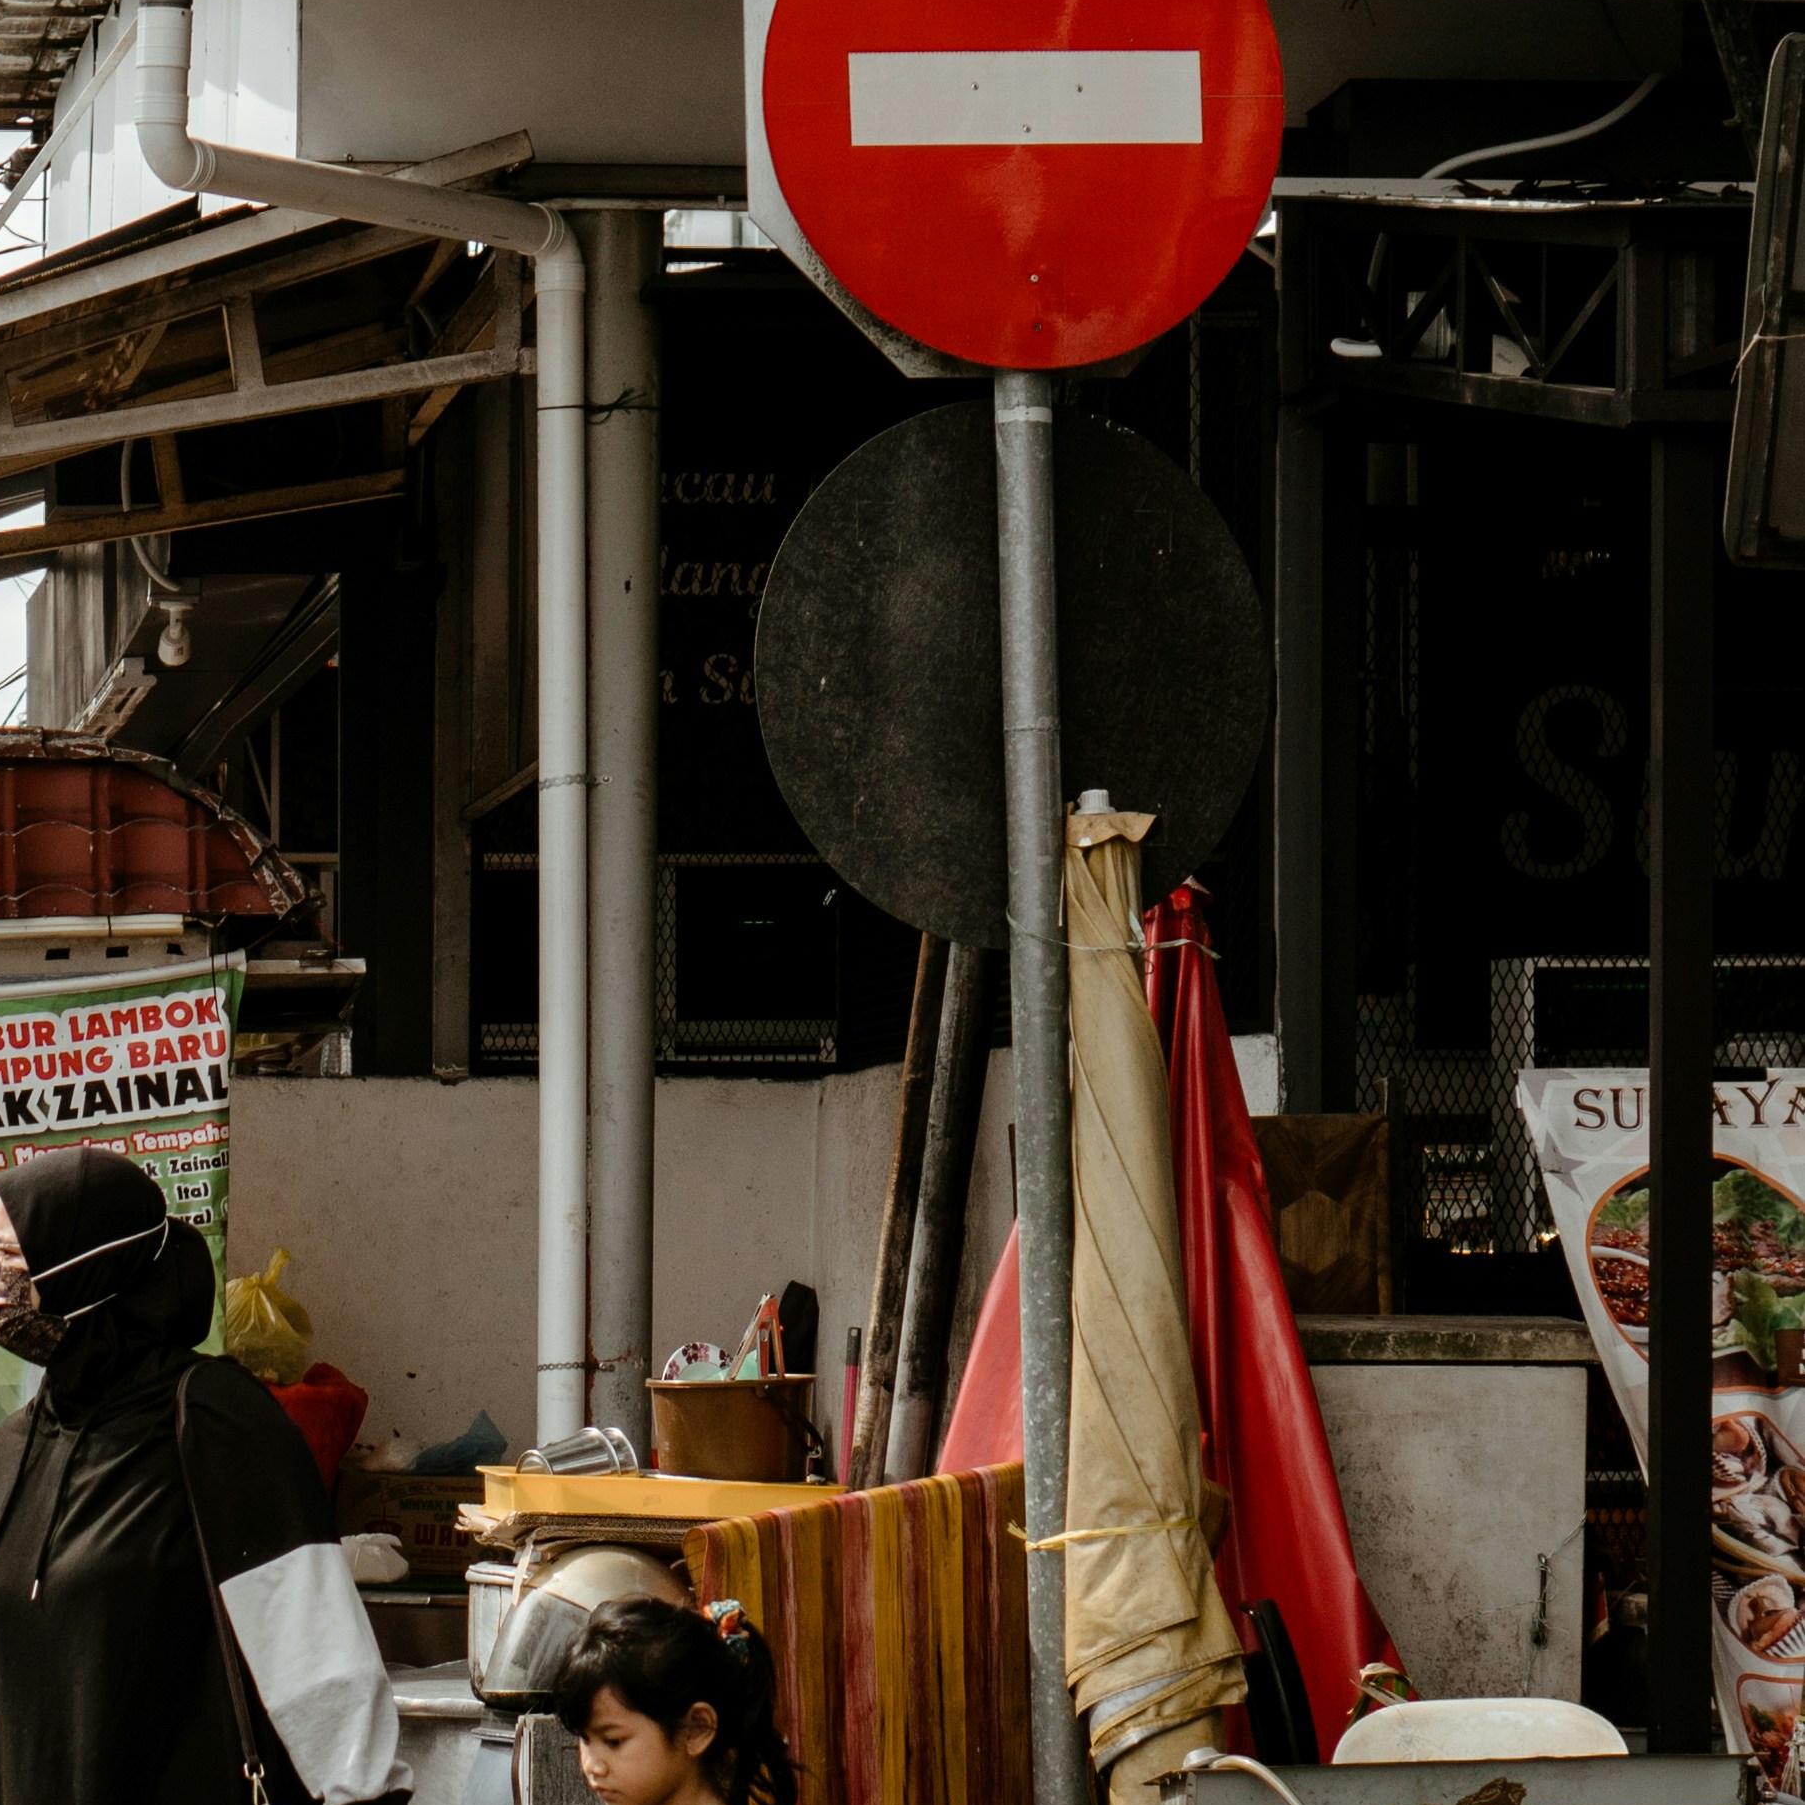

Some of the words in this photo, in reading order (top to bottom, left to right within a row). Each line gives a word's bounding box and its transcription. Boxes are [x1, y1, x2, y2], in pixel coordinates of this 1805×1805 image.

[68, 996, 220, 1042] LAMBOK
[127, 1029, 226, 1070] BARU
[50, 1063, 230, 1122] ZAINAL
